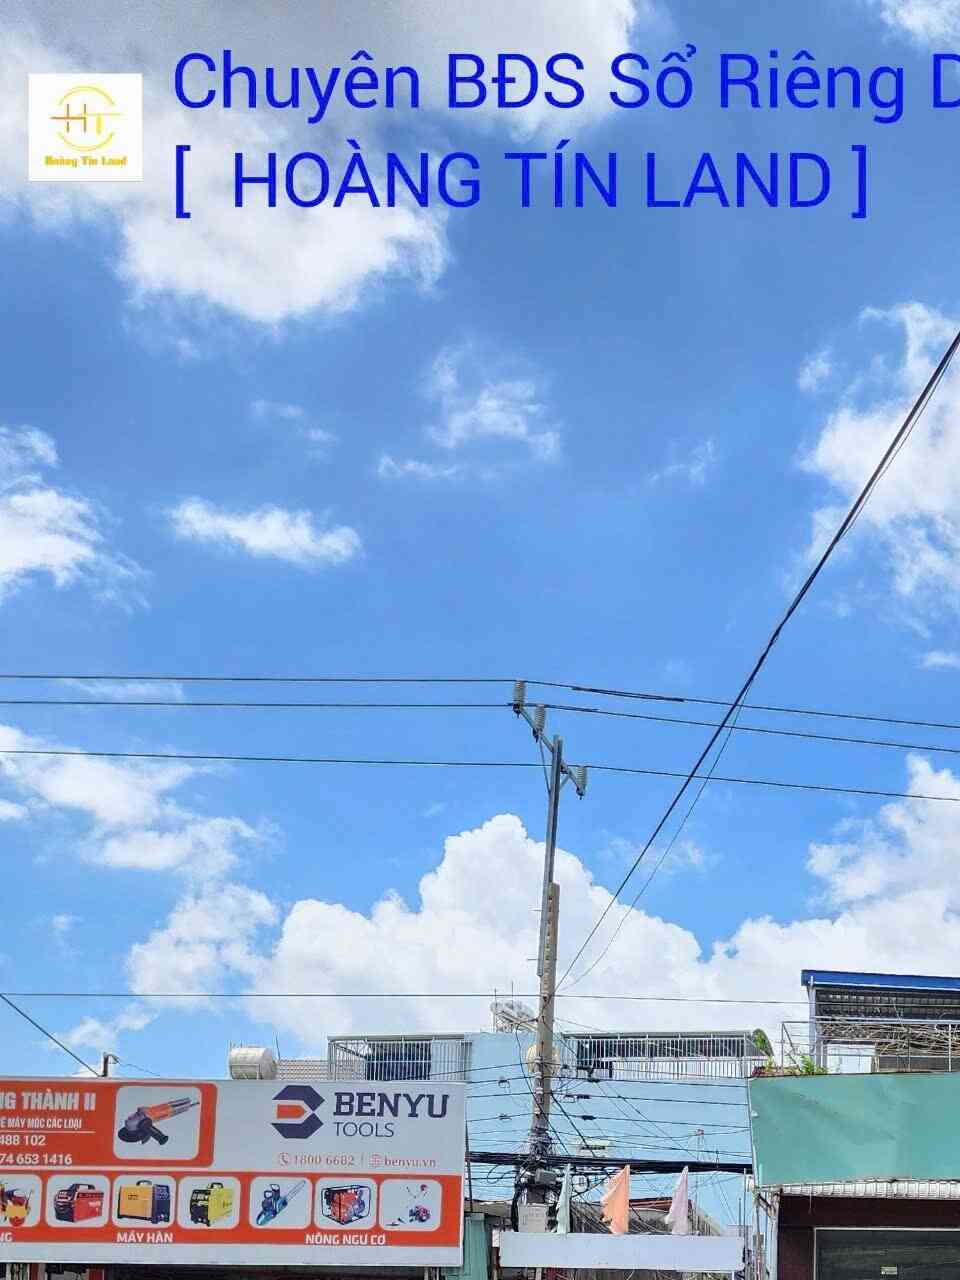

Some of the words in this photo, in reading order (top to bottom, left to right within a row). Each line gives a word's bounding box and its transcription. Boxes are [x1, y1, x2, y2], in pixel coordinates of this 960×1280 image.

[21, 1088, 80, 1111] THÀNH
[83, 1092, 96, 1111] II
[333, 1091, 449, 1119] BENYU
[8, 1115, 26, 1129] MÁY
[46, 1115, 62, 1129] CÁC
[63, 1118, 82, 1130] LOẠI
[333, 1121, 395, 1138] TOOLS
[23, 1134, 47, 1147] 102
[0, 1153, 14, 1165] 74
[16, 1153, 40, 1165] 653
[42, 1152, 73, 1165] 1416
[384, 1156, 437, 1170] benyu.vn
[116, 1230, 145, 1243] MÁY
